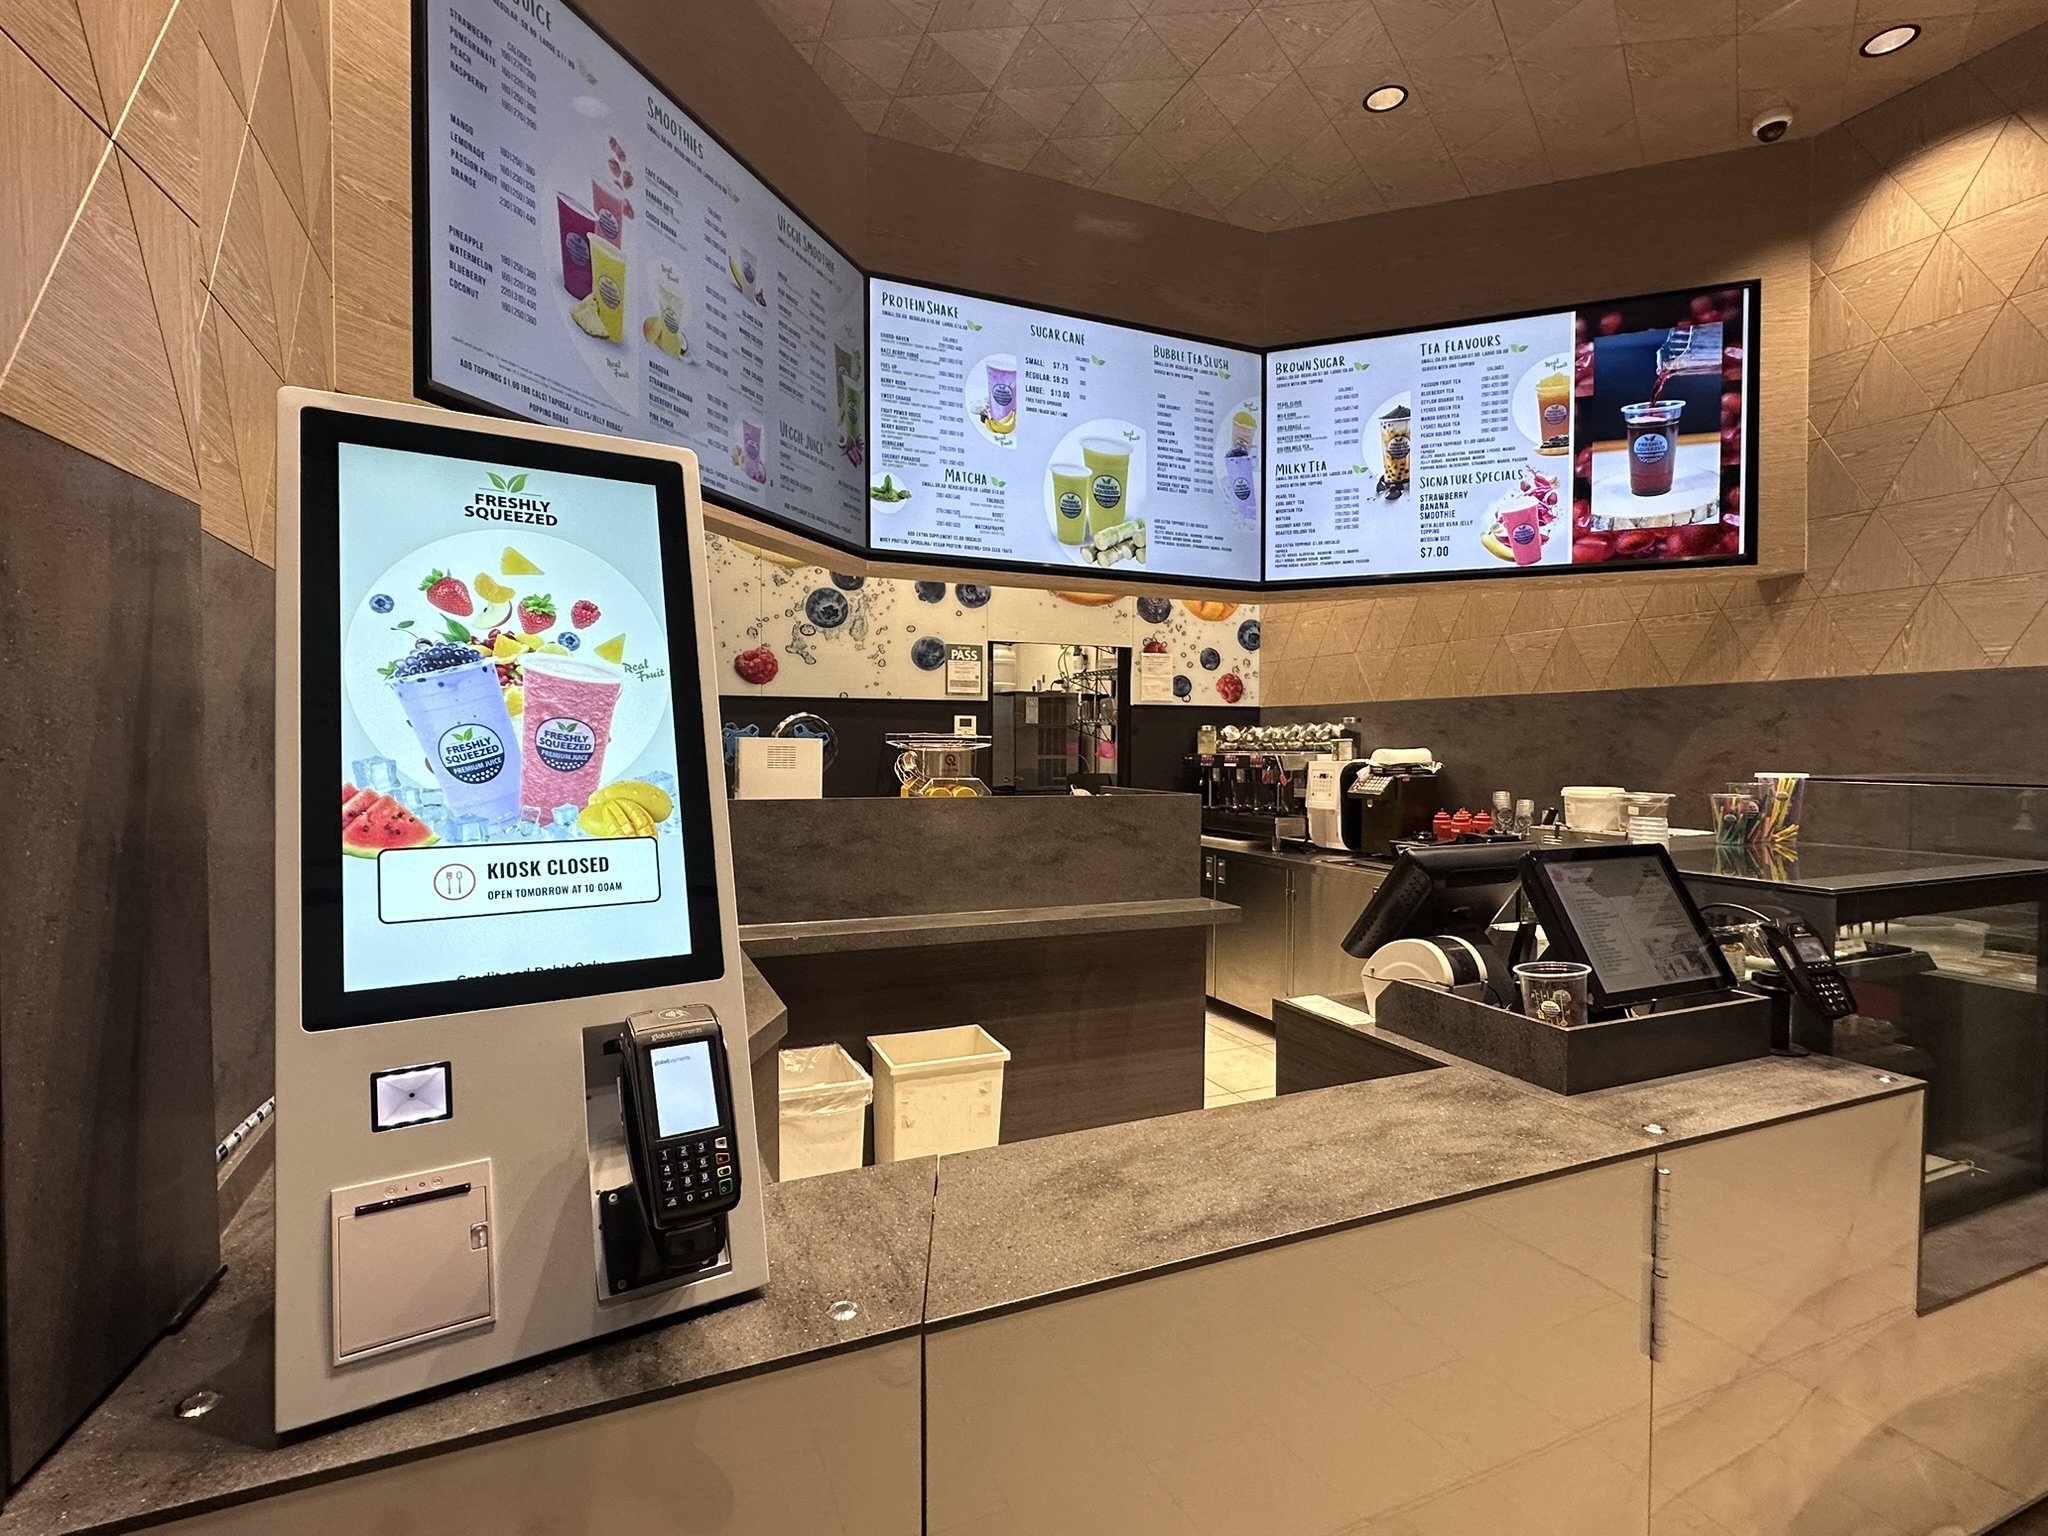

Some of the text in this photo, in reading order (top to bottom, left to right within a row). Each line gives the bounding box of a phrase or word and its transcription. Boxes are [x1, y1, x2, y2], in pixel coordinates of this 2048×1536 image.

[449, 7, 493, 48] STRAWBERRY
[449, 24, 496, 68] POMEGRANATE
[450, 42, 472, 66] PEACH
[450, 60, 488, 94] RASPBERRY
[450, 113, 473, 136] MANGO
[647, 95, 704, 160] SMOOTHIES
[450, 131, 485, 161] LEMONADE
[450, 148, 498, 185] PASSION FRUIT
[450, 166, 477, 190] ORANGE
[449, 224, 484, 252] PINEAPPLE
[777, 212, 802, 246] VEGGIE
[802, 235, 836, 276] SMOOTHIE
[449, 241, 493, 273] WATERMELON
[449, 259, 486, 286] BLUEBERRY
[449, 277, 479, 299] COCONUT
[882, 292, 959, 319] PROTEIN SHAKE
[1030, 324, 1086, 346] SUGAR CANE
[1420, 342, 1440, 357] TEA
[1445, 334, 1501, 354] FLAVOURS
[1025, 357, 1069, 371] SMALL: $7.75
[1153, 344, 1185, 362] BUBBLE
[1186, 351, 1203, 366] TEA
[1203, 354, 1229, 370] SLUSH
[1275, 360, 1312, 375] BROWN
[1313, 355, 1346, 371] SUGAR
[459, 358, 520, 391] ADD TOPPINGS $1.00
[1025, 370, 1069, 385] REGULAR: $9.25
[649, 375, 677, 395] STRAWBERRY
[1025, 385, 1070, 399] LARGE: $13.00
[1421, 389, 1445, 397] BLUEBERRY
[649, 392, 673, 410] BLUEBERRY
[528, 402, 570, 425] POPPING BOBAS
[780, 418, 803, 446] VEGGIE
[805, 434, 824, 457] JUICE
[944, 468, 988, 486] MATCHA
[1275, 462, 1306, 476] MILKY
[1308, 460, 1327, 473] TEA
[1419, 469, 1524, 489] SIGNATURE SPECIALS
[475, 492, 551, 514] FRESHLY
[1420, 491, 1468, 502] STRAWBERRY
[1420, 502, 1449, 511] BANANA
[464, 505, 558, 527] SQUEEZED
[1420, 510, 1456, 520] SMOOTHIE
[1420, 546, 1449, 558] $7.00
[951, 649, 978, 661] PASS
[623, 659, 650, 674] Real
[636, 667, 666, 683] Fruit
[445, 736, 492, 755] FRESHLY
[539, 737, 592, 751] SQUEEZED
[544, 729, 589, 743] FRESHLY
[445, 744, 500, 765] SQUEEZED
[541, 750, 589, 761] PREMIUM JUICE
[453, 756, 503, 775] PREMIUM JUICE
[487, 856, 610, 880] KIOSK CLOSED
[487, 881, 623, 900] OPEN TOMORROW AT 10:00AM
[651, 1027, 703, 1041] globalpayments
[686, 1193, 693, 1202] 0
